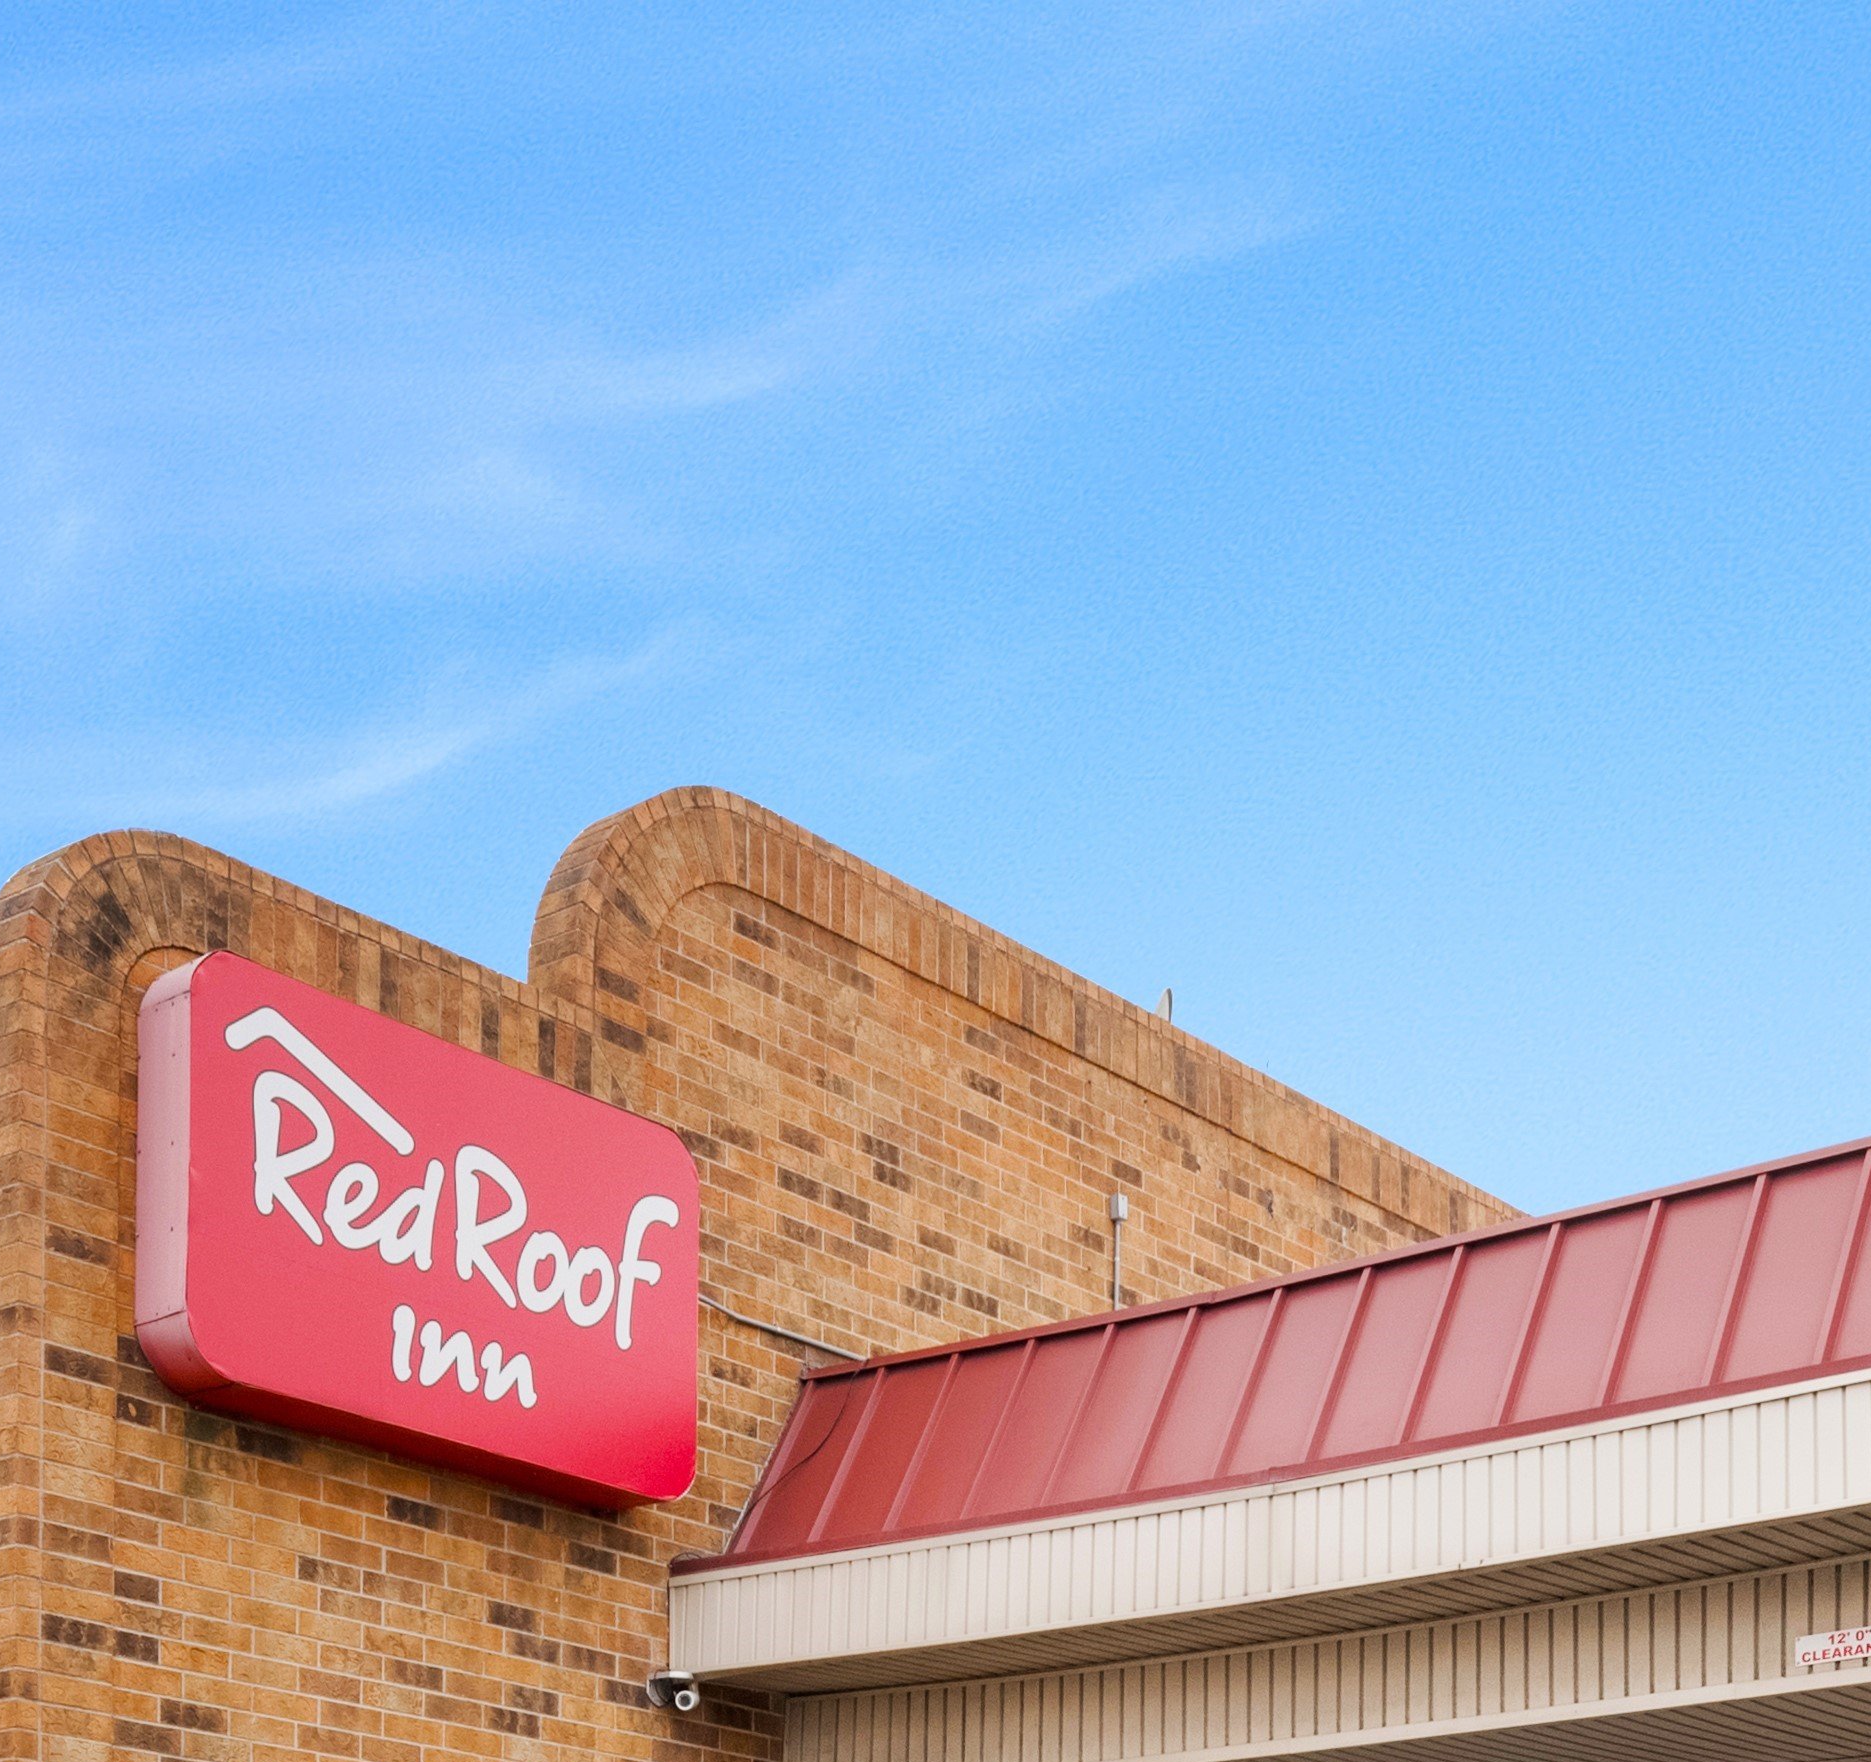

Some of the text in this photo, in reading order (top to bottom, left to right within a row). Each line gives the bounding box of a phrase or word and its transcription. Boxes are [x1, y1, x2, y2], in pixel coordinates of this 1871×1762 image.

[253, 1069, 679, 1350] Red Roof
[391, 1304, 537, 1409] Inn
